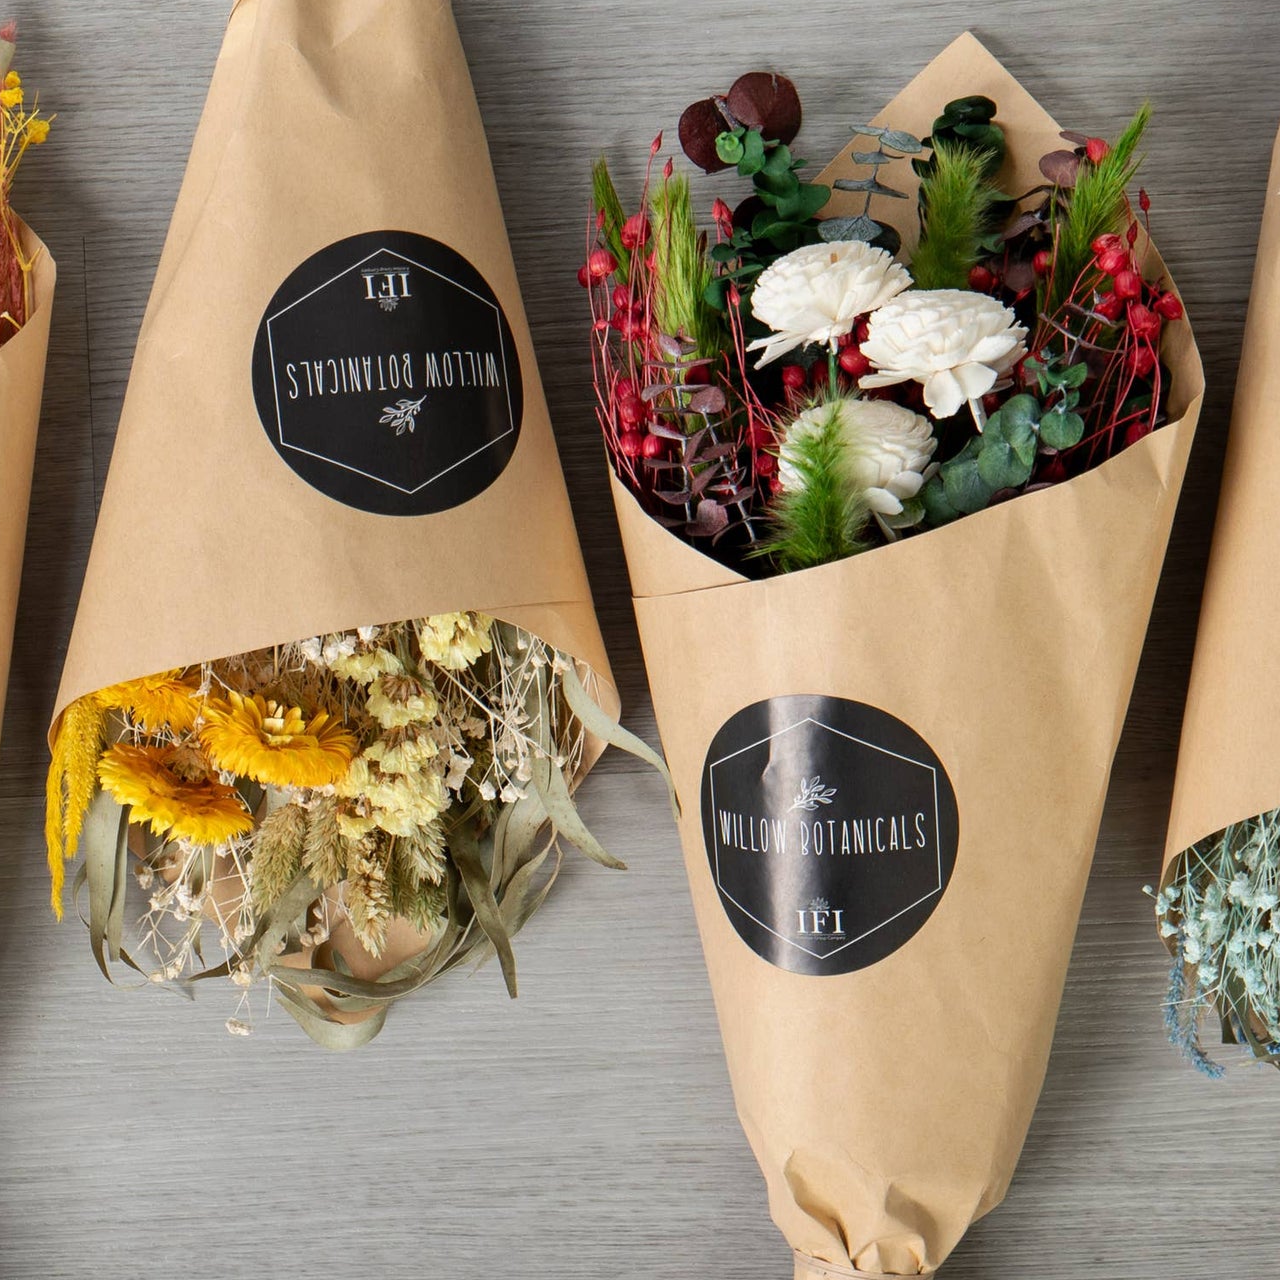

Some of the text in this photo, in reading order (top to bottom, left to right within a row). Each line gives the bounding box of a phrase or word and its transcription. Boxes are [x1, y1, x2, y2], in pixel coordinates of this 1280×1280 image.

[361, 273, 412, 300] IFI
[286, 351, 500, 399] WILLOW BOTANICALS
[719, 810, 926, 855] WILLOW BOTANICALS
[796, 909, 845, 934] IFI
